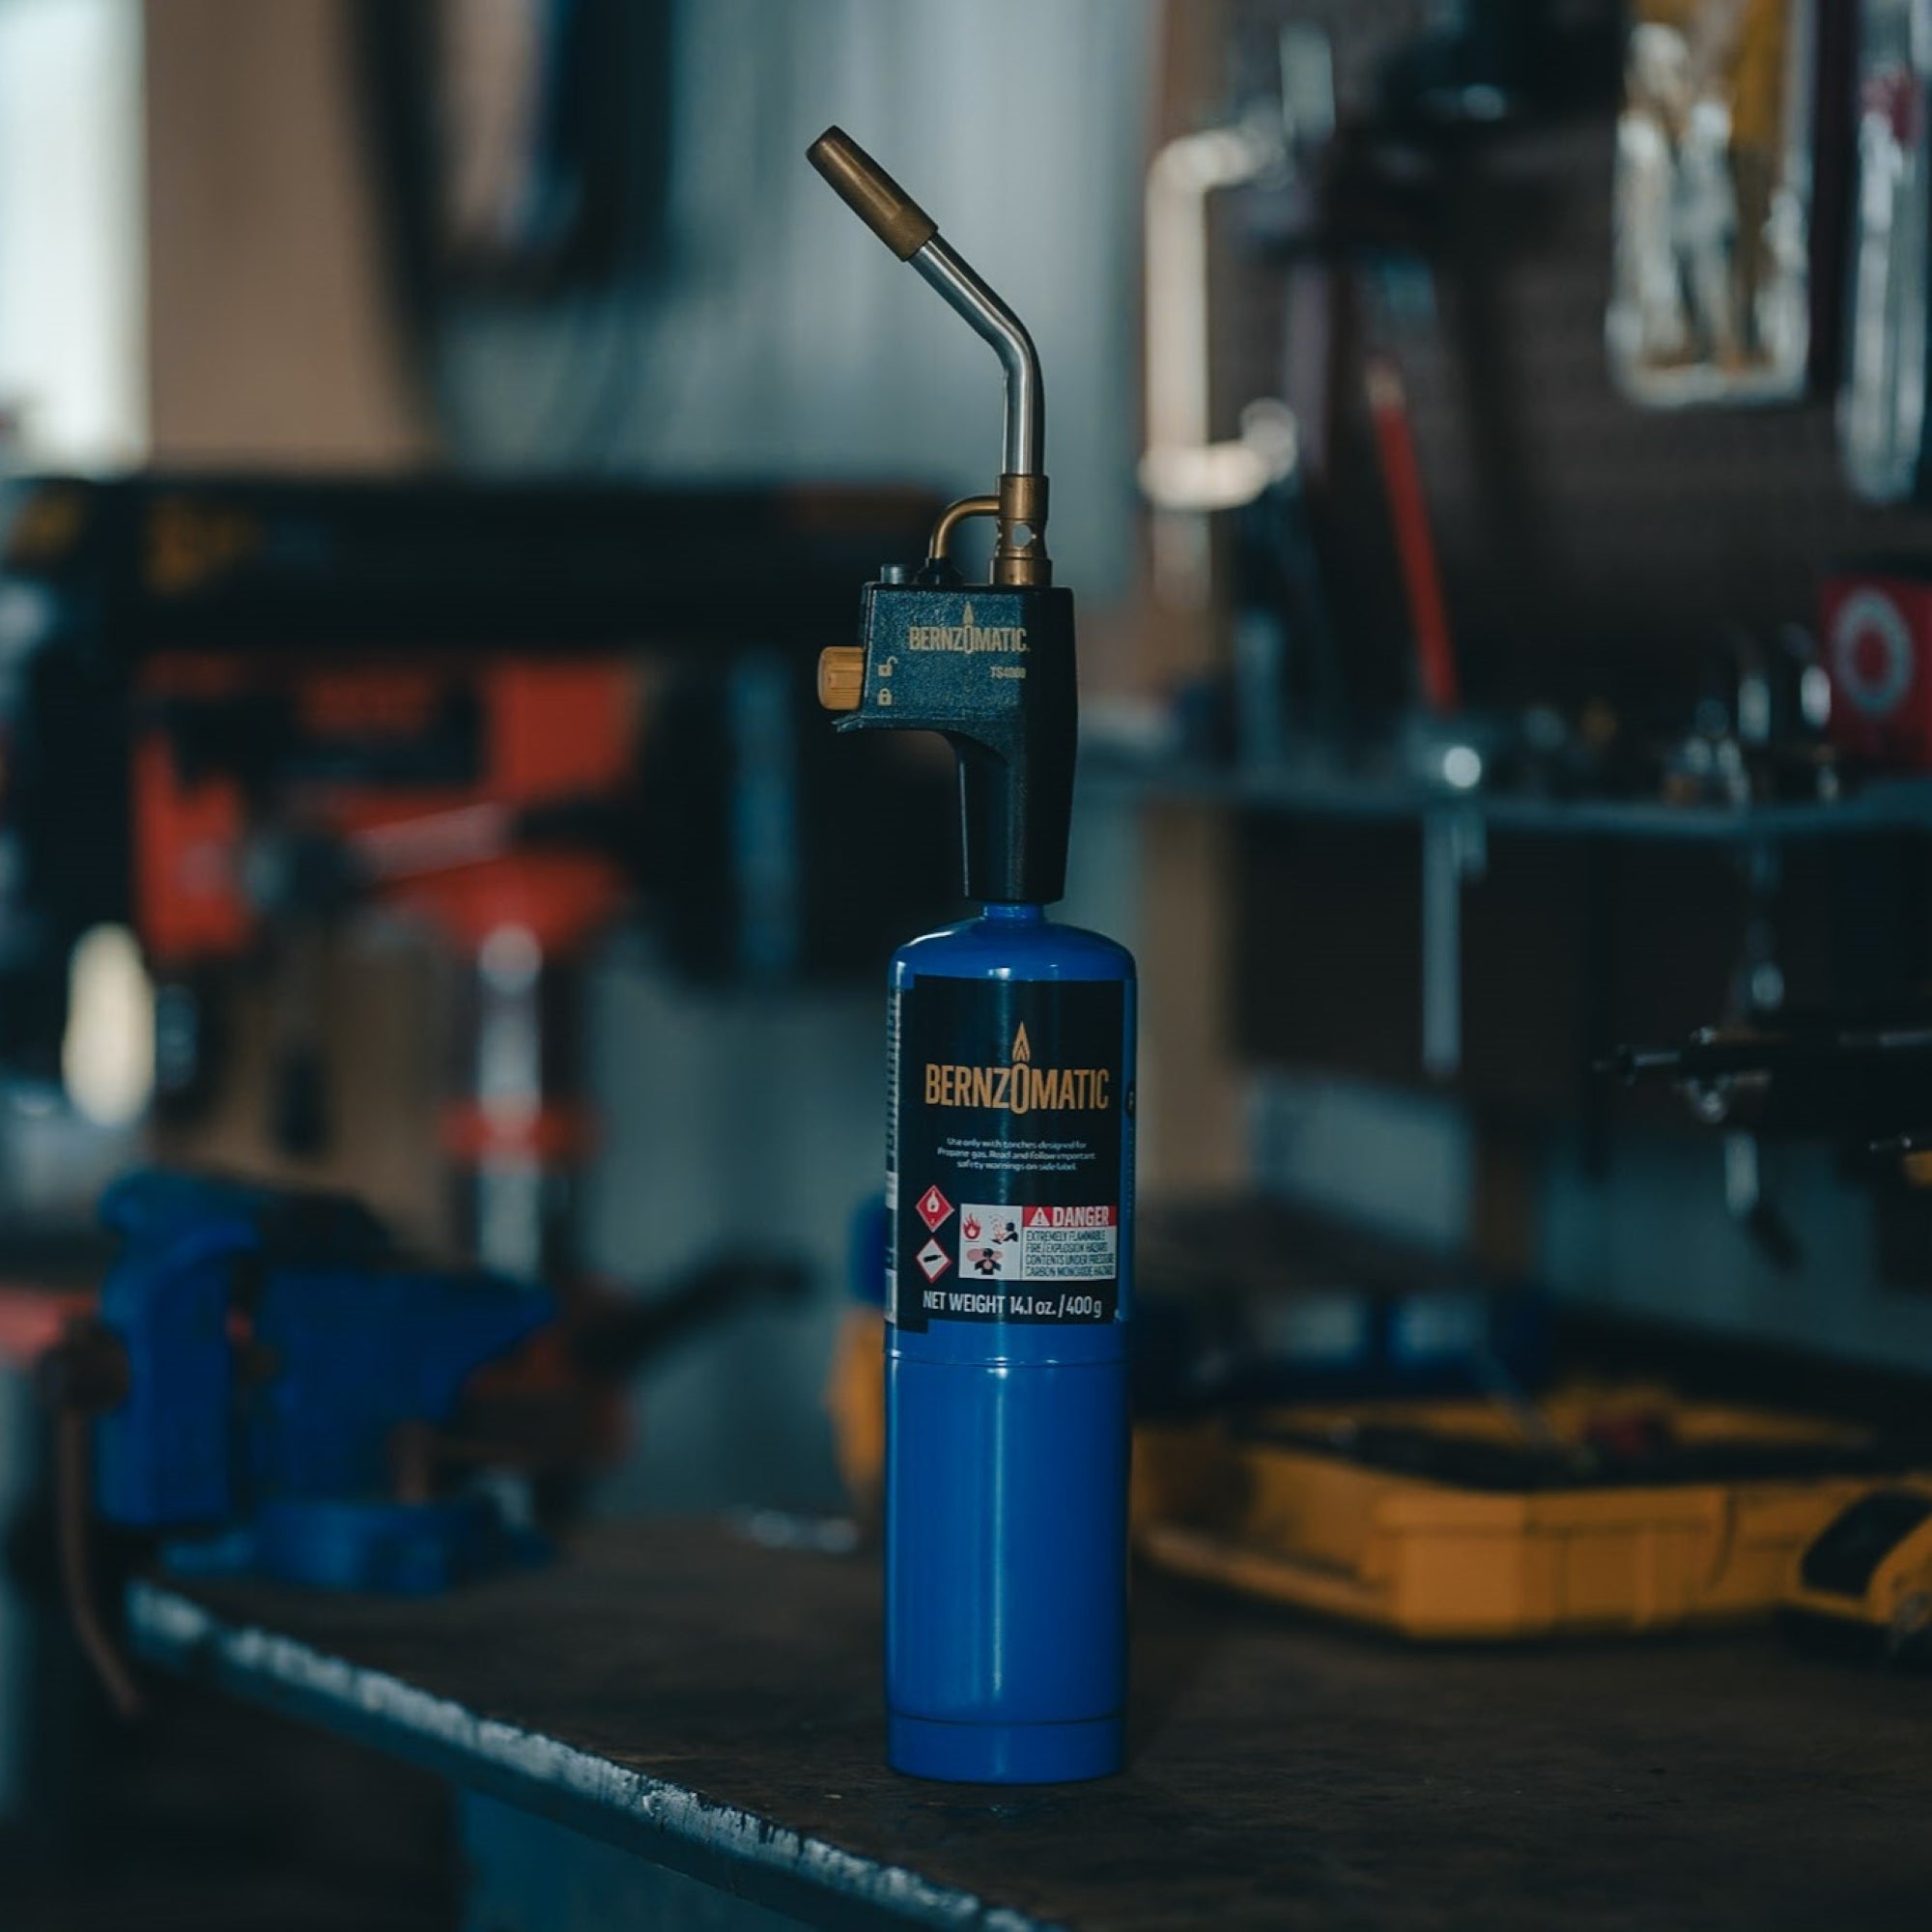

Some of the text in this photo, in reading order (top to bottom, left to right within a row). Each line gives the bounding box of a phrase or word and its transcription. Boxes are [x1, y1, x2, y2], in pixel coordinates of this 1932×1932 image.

[910, 626, 1027, 654] BERNZOMATIC
[924, 1063, 1109, 1115] BERNZOMATIC
[981, 1139, 1002, 1149] with
[1012, 1151, 1029, 1160] and
[1053, 1206, 1109, 1227] DANGER
[1026, 1230, 1067, 1241] EXTREMELY
[923, 1291, 947, 1310] NET
[949, 1293, 1006, 1314] WEIGHT
[1009, 1295, 1033, 1316] 14.1
